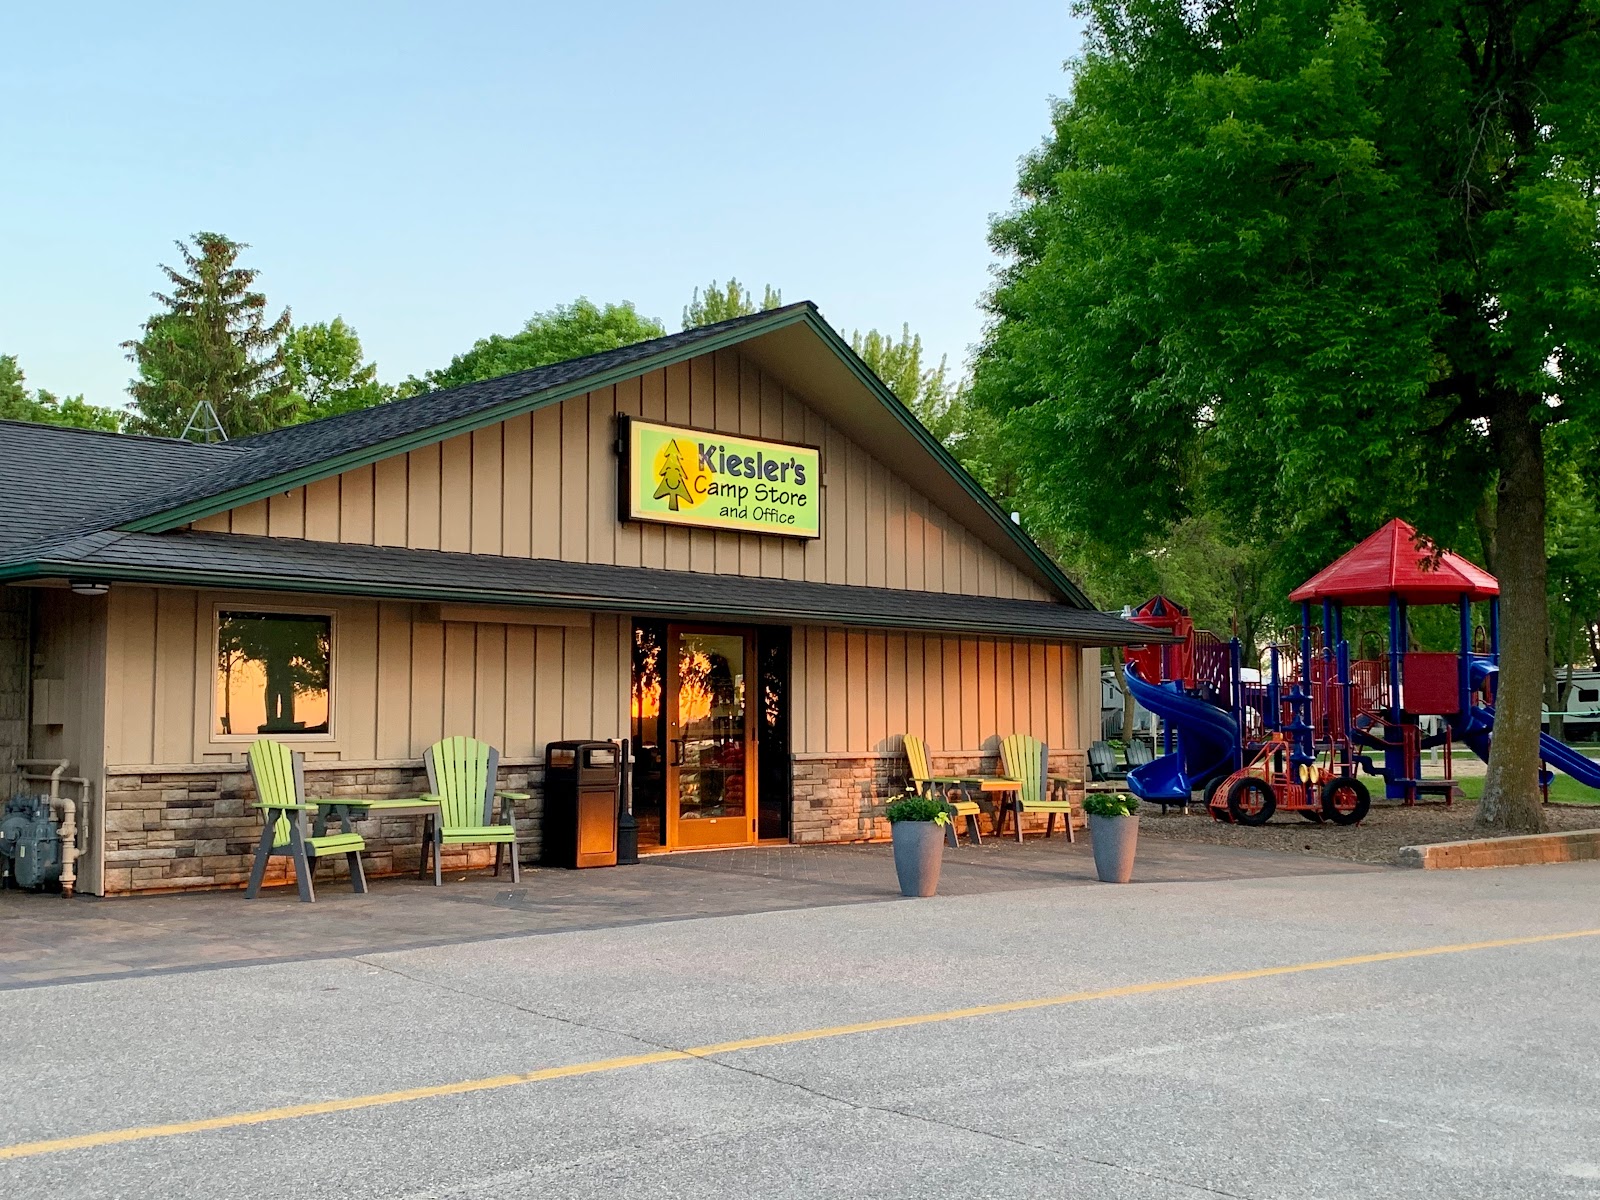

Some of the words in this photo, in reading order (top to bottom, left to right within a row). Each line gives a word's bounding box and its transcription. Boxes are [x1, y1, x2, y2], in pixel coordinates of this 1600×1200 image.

[698, 443, 806, 486] Kiesler's
[694, 475, 748, 506] Camp
[755, 483, 807, 507] Store
[719, 505, 747, 519] and
[753, 506, 795, 525] Office
